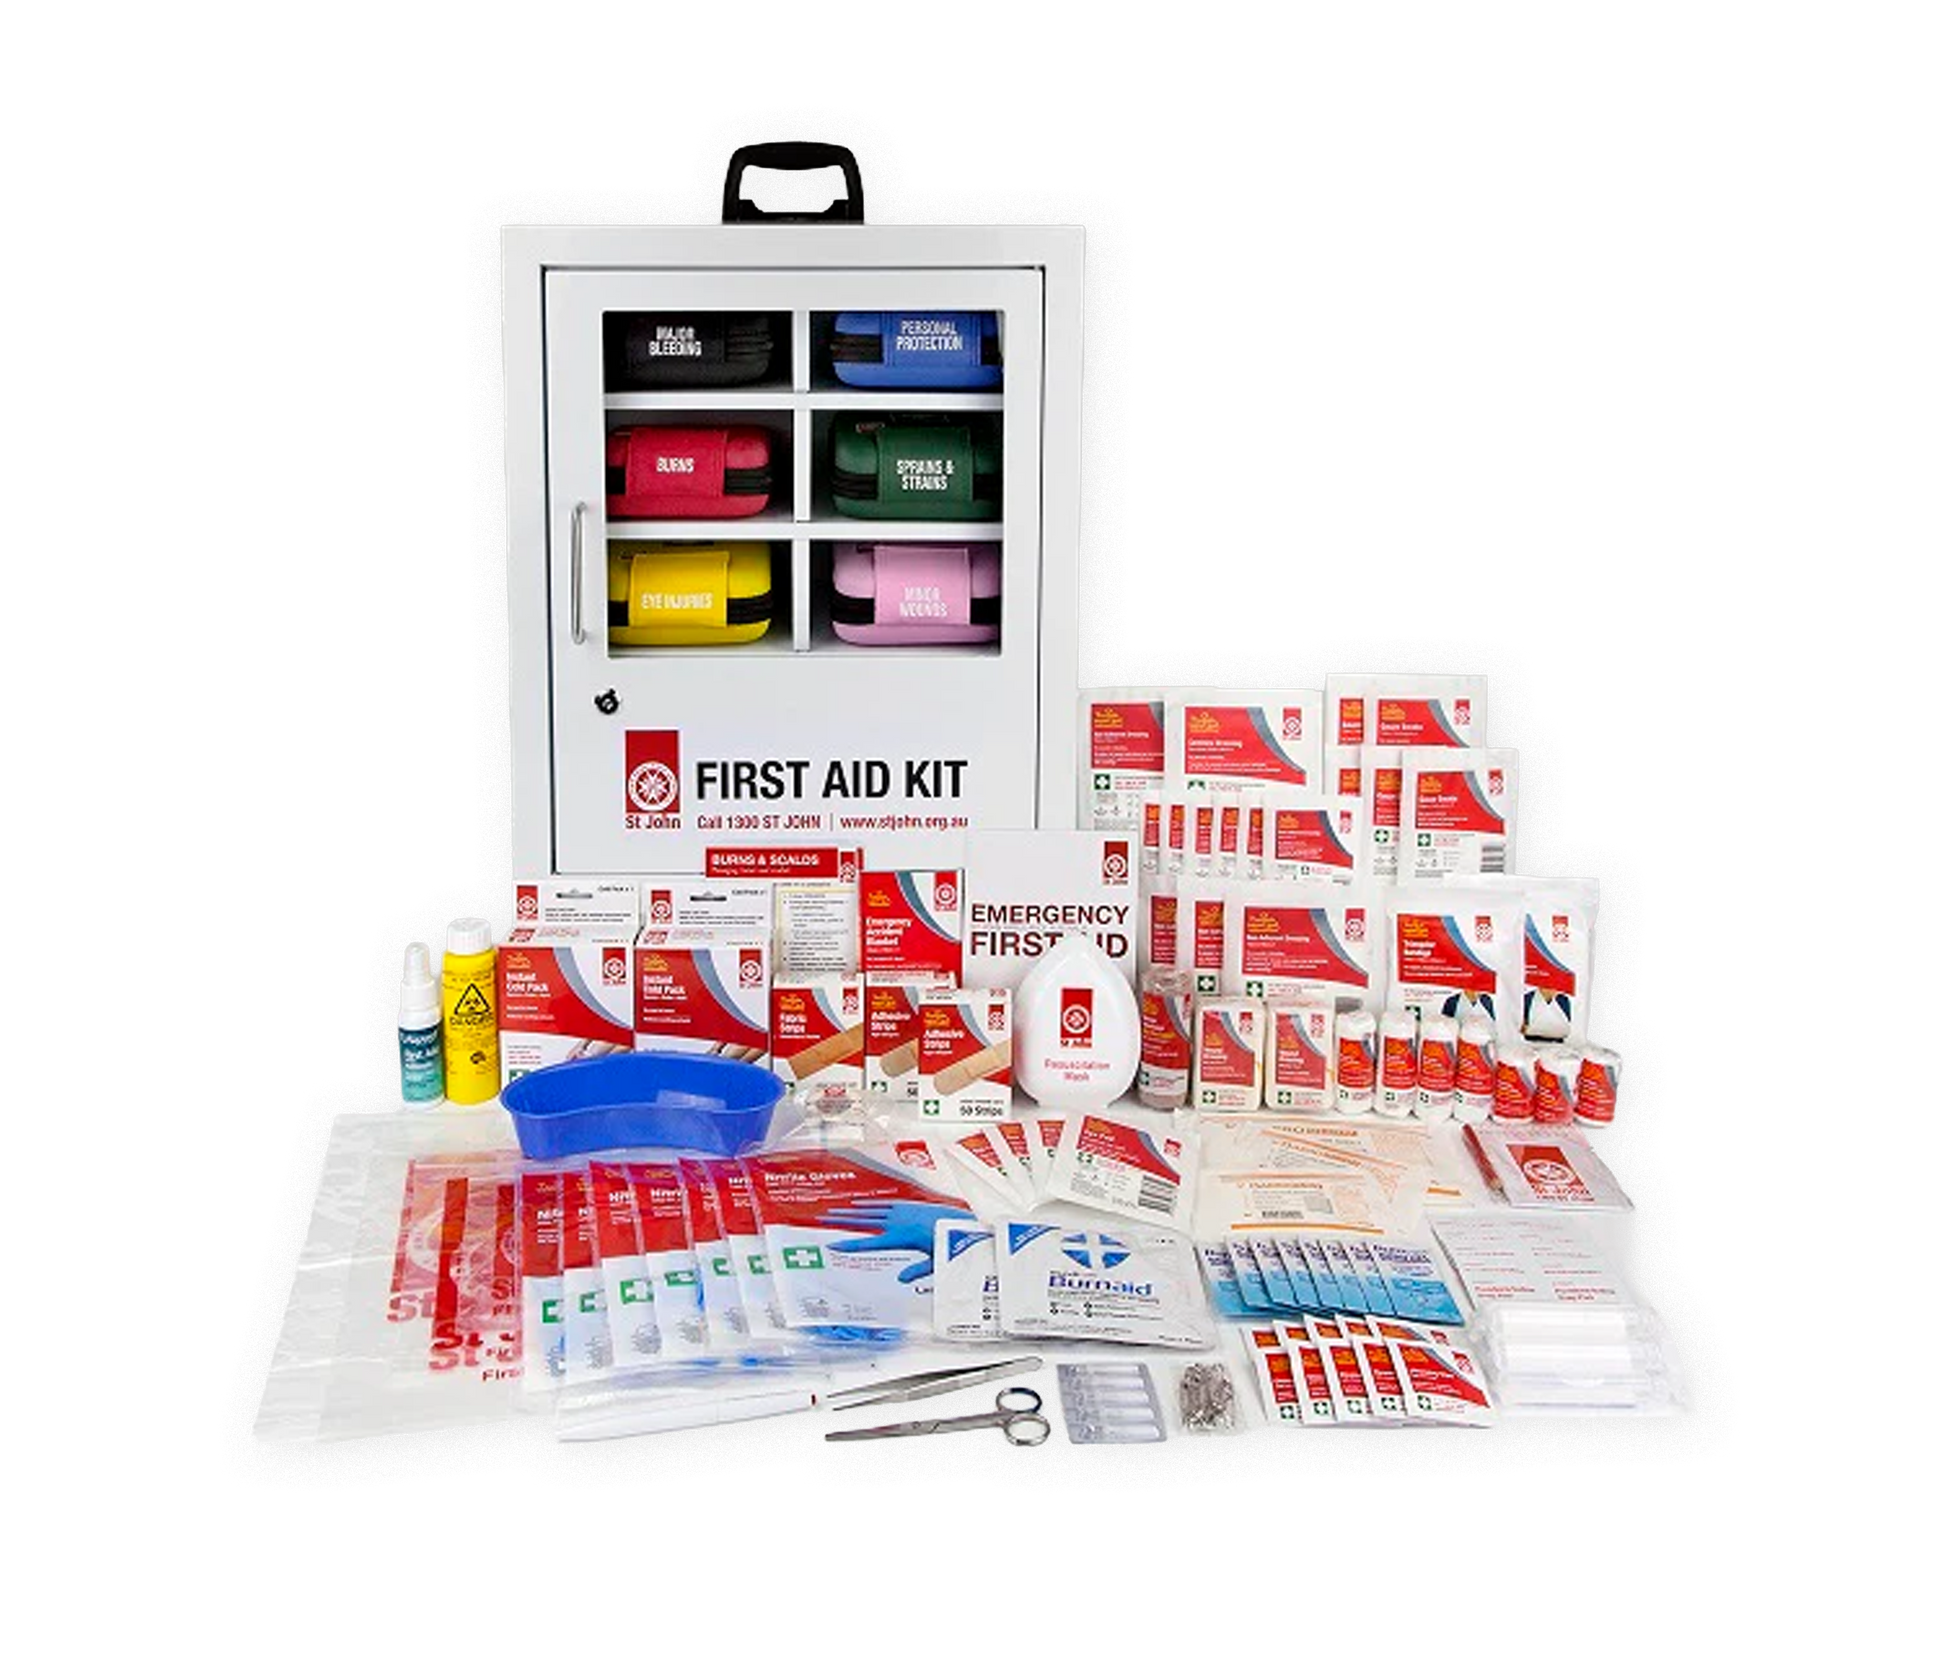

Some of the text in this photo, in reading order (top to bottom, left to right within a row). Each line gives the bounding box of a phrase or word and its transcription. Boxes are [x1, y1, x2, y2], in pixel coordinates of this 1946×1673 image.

[655, 326, 696, 341] MAJOR
[901, 320, 957, 336] PERSONAL
[648, 340, 702, 357] BLEEDING
[896, 336, 964, 352] PROTECTION
[656, 456, 694, 474] BURNS
[896, 460, 955, 476] SPRAINS &
[901, 475, 949, 491] STRAINS
[641, 593, 713, 609] EYE INJURIES
[903, 586, 941, 601] MINOR
[899, 601, 949, 618] WOUNDS
[696, 760, 969, 800] FIRST AID KIT
[625, 814, 682, 829] St John
[697, 815, 969, 832] Call 1300 ST JOHN www.stjohn.org.au
[711, 853, 755, 866] BURNS
[756, 853, 767, 866] &
[971, 903, 1130, 925] EMERGENCY
[970, 931, 1065, 957] FIRST
[974, 1106, 1004, 1119] Strips
[810, 1170, 857, 1183] Gloves
[1048, 1274, 1153, 1297] Burnaid
